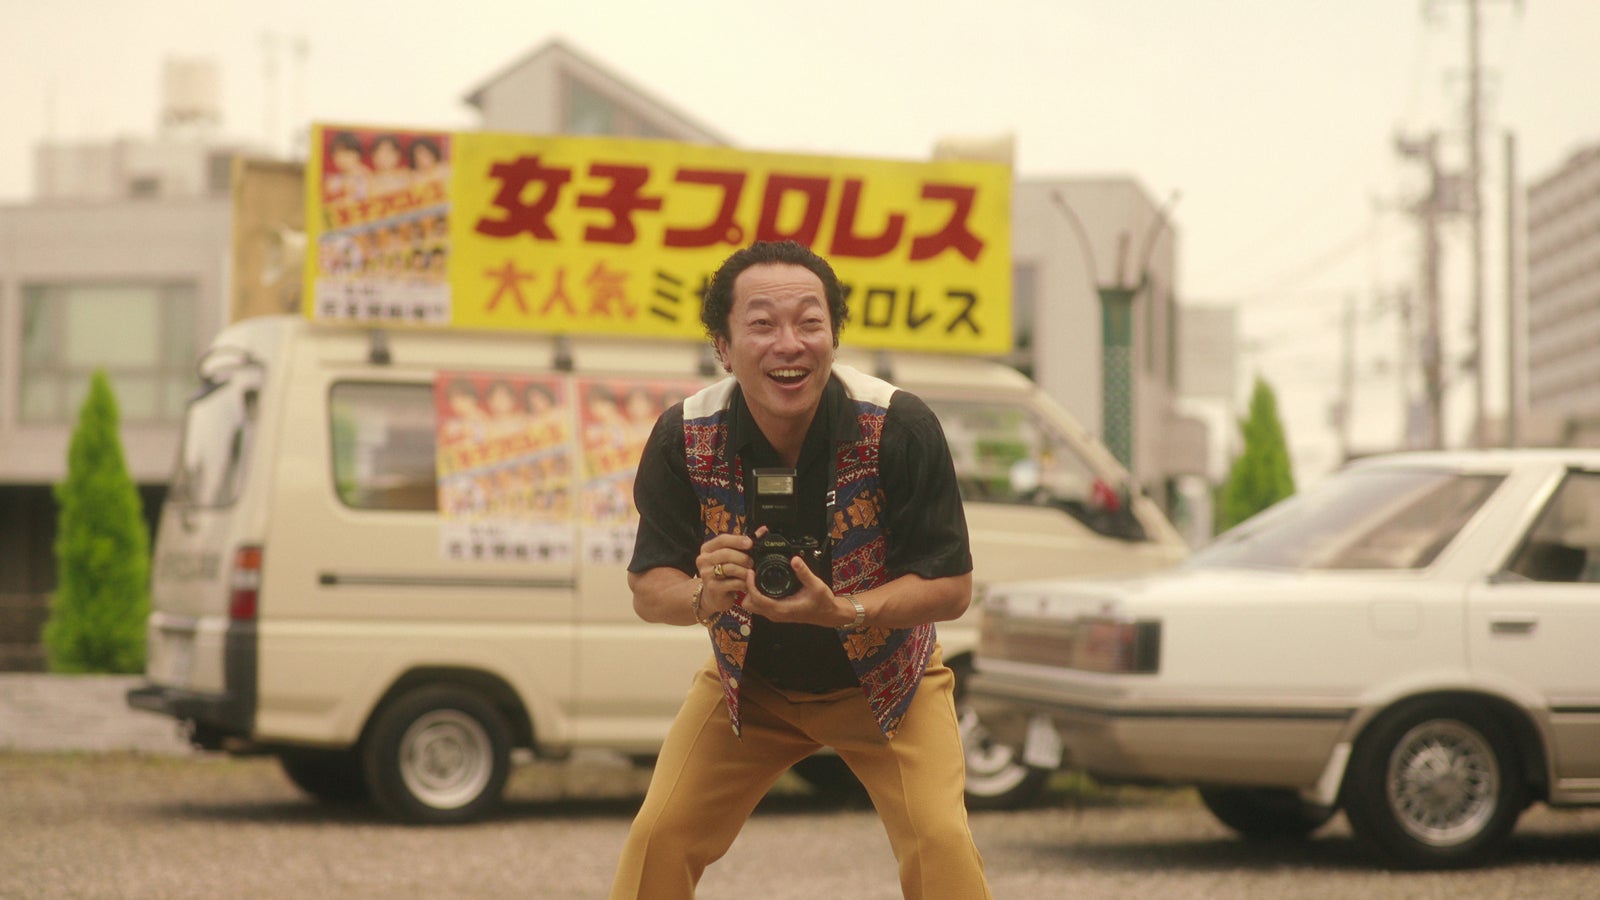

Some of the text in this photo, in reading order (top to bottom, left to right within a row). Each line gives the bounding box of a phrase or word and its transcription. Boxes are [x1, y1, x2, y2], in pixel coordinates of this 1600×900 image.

[474, 154, 985, 263] 女子プロレス
[485, 260, 636, 319] 大人気
[764, 540, 787, 548] Canon
